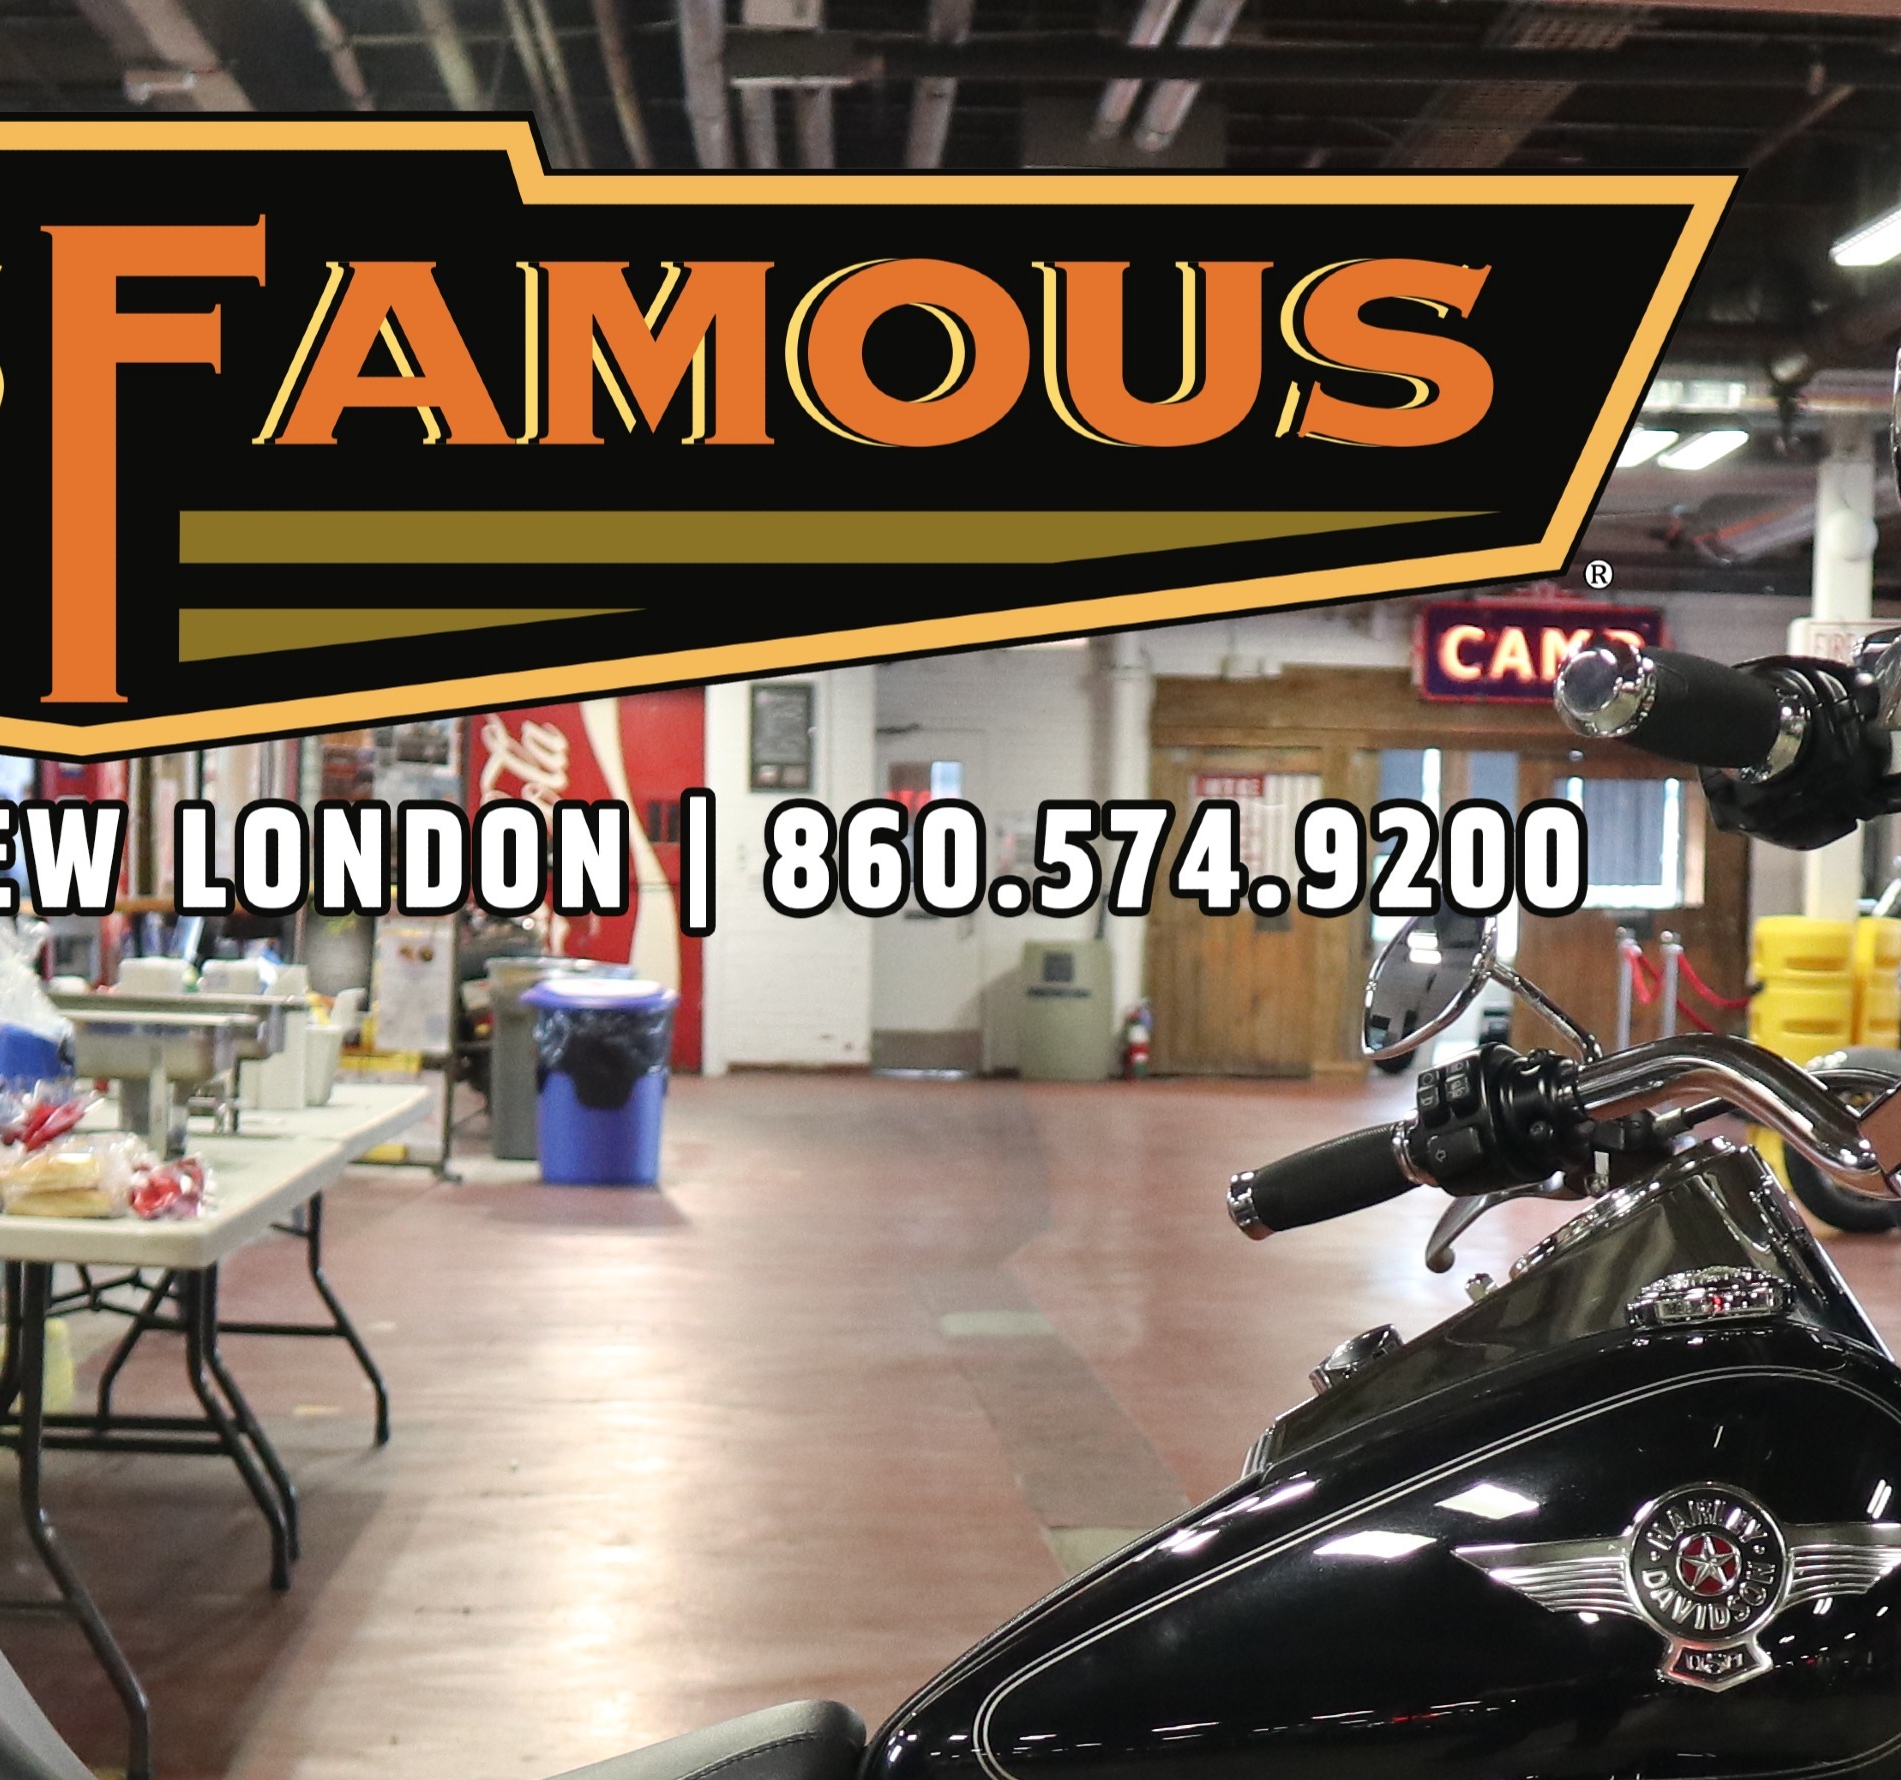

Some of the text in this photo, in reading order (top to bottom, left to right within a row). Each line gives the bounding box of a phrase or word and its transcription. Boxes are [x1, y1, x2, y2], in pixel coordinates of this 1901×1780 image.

[1435, 624, 1646, 684] CAM
[1646, 1498, 1770, 1552] HARLEY
[1641, 1559, 1777, 1632] DAVIDSON
